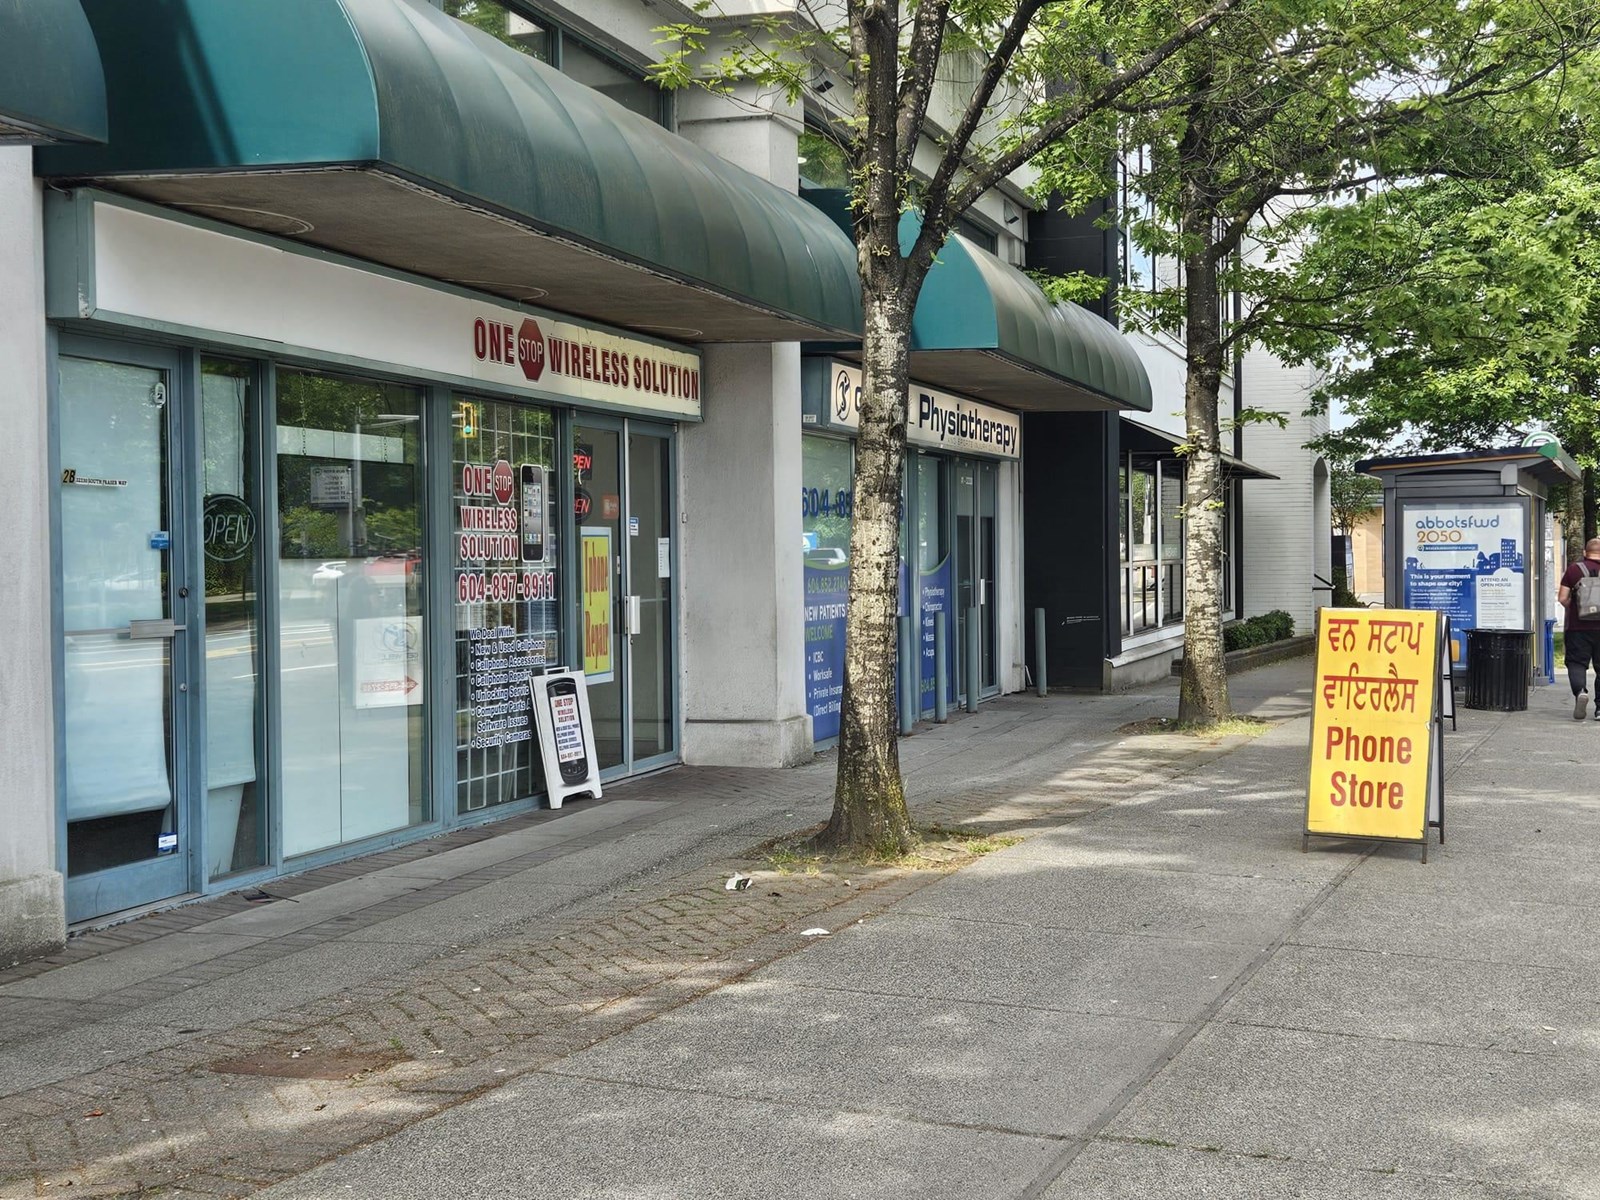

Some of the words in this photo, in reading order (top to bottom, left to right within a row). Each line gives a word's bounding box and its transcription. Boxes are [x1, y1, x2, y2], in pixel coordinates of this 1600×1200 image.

[474, 317, 515, 366] ONE
[519, 337, 543, 364] STOP
[547, 335, 629, 388] WIRELESS
[633, 356, 699, 401] SOLUTION
[919, 393, 1017, 454] Physiotherapy
[573, 455, 592, 469] PEN
[63, 469, 76, 483] 2B
[463, 464, 492, 496] ONE
[494, 475, 512, 491] STOP
[574, 499, 591, 514] EN
[461, 506, 517, 532] WIRELESS
[1415, 514, 1499, 529] abbotsfwd
[1417, 530, 1462, 543] 2050
[460, 534, 518, 561] SOLUTION
[458, 572, 554, 604] 604-897-8911
[804, 607, 818, 621] NEW
[819, 604, 846, 620] PATIENTS
[469, 628, 481, 640] We
[482, 627, 497, 639] Deal
[585, 610, 608, 669] Repair
[1327, 618, 1359, 652] ਵਨ
[1367, 620, 1424, 655] ਸਟਾਪ
[475, 643, 491, 656] New
[499, 641, 515, 653] Used
[516, 638, 546, 653] Cellphone
[475, 657, 508, 673] Cellphone
[508, 653, 546, 668] Accessories
[475, 673, 508, 688] Cellphone
[1323, 662, 1419, 713] ਵਾਇਰਲੈਸ
[476, 687, 508, 702] Unlocking
[509, 684, 530, 697] Servic
[476, 702, 508, 718] Computer
[508, 700, 525, 712] Parts
[477, 720, 506, 733] Software
[507, 716, 528, 728] Issues
[476, 733, 504, 749] Security
[505, 729, 532, 743] Cameras
[1325, 726, 1412, 764] Phone
[1330, 771, 1404, 809] Store
